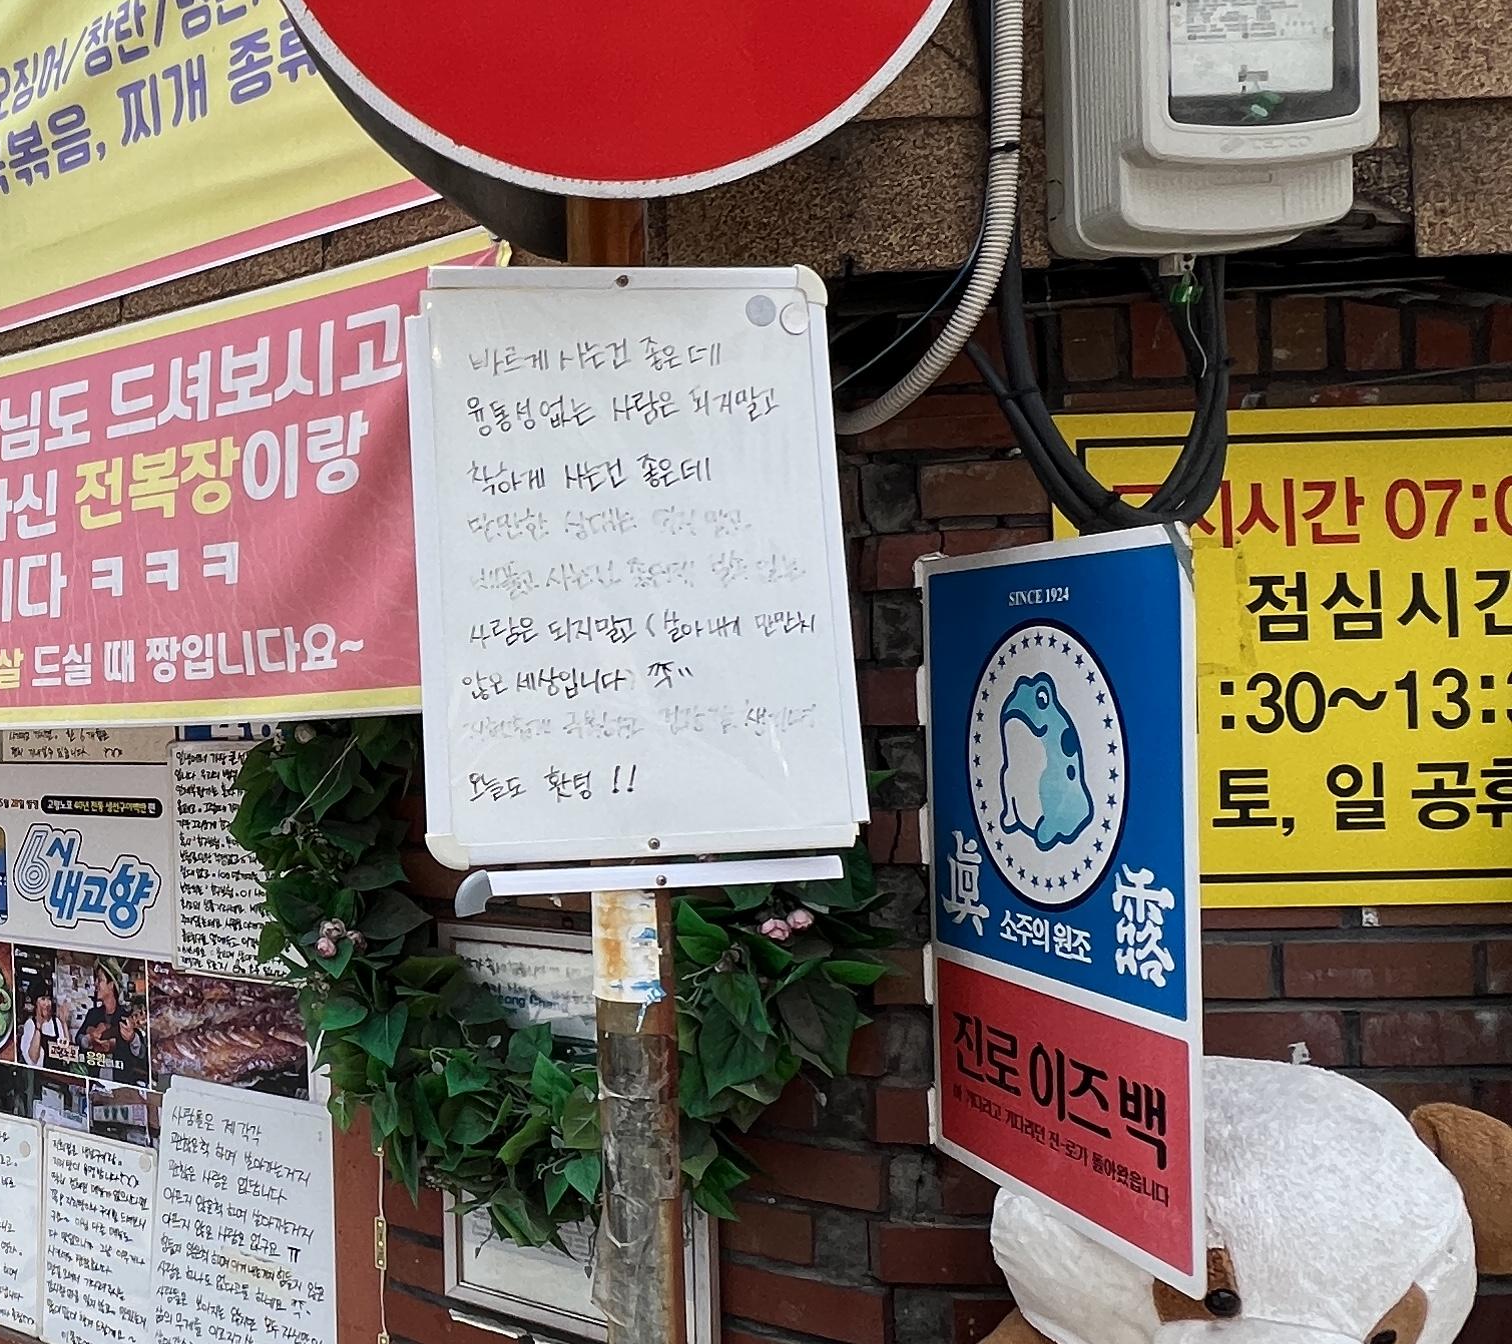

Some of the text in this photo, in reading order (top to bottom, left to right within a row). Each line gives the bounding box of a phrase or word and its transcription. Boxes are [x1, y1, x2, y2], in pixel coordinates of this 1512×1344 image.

[116, 53, 207, 147] 찌개
[104, 302, 404, 440] 드셔보시고
[74, 407, 370, 532] 전복장이랑
[466, 460, 545, 496] 착하게
[636, 452, 711, 488] 좋은데
[1008, 586, 1070, 607] SINCE 1924
[31, 641, 94, 688] 드실
[104, 638, 135, 683] 때
[145, 622, 366, 686] 짱입니다요~
[1220, 668, 1512, 734] :30~13:
[468, 770, 527, 803] 오늘도
[1212, 768, 1295, 837] 토,
[1326, 761, 1386, 831] 일
[49, 863, 155, 930] 내고향
[999, 910, 1093, 965] 소주의 원조
